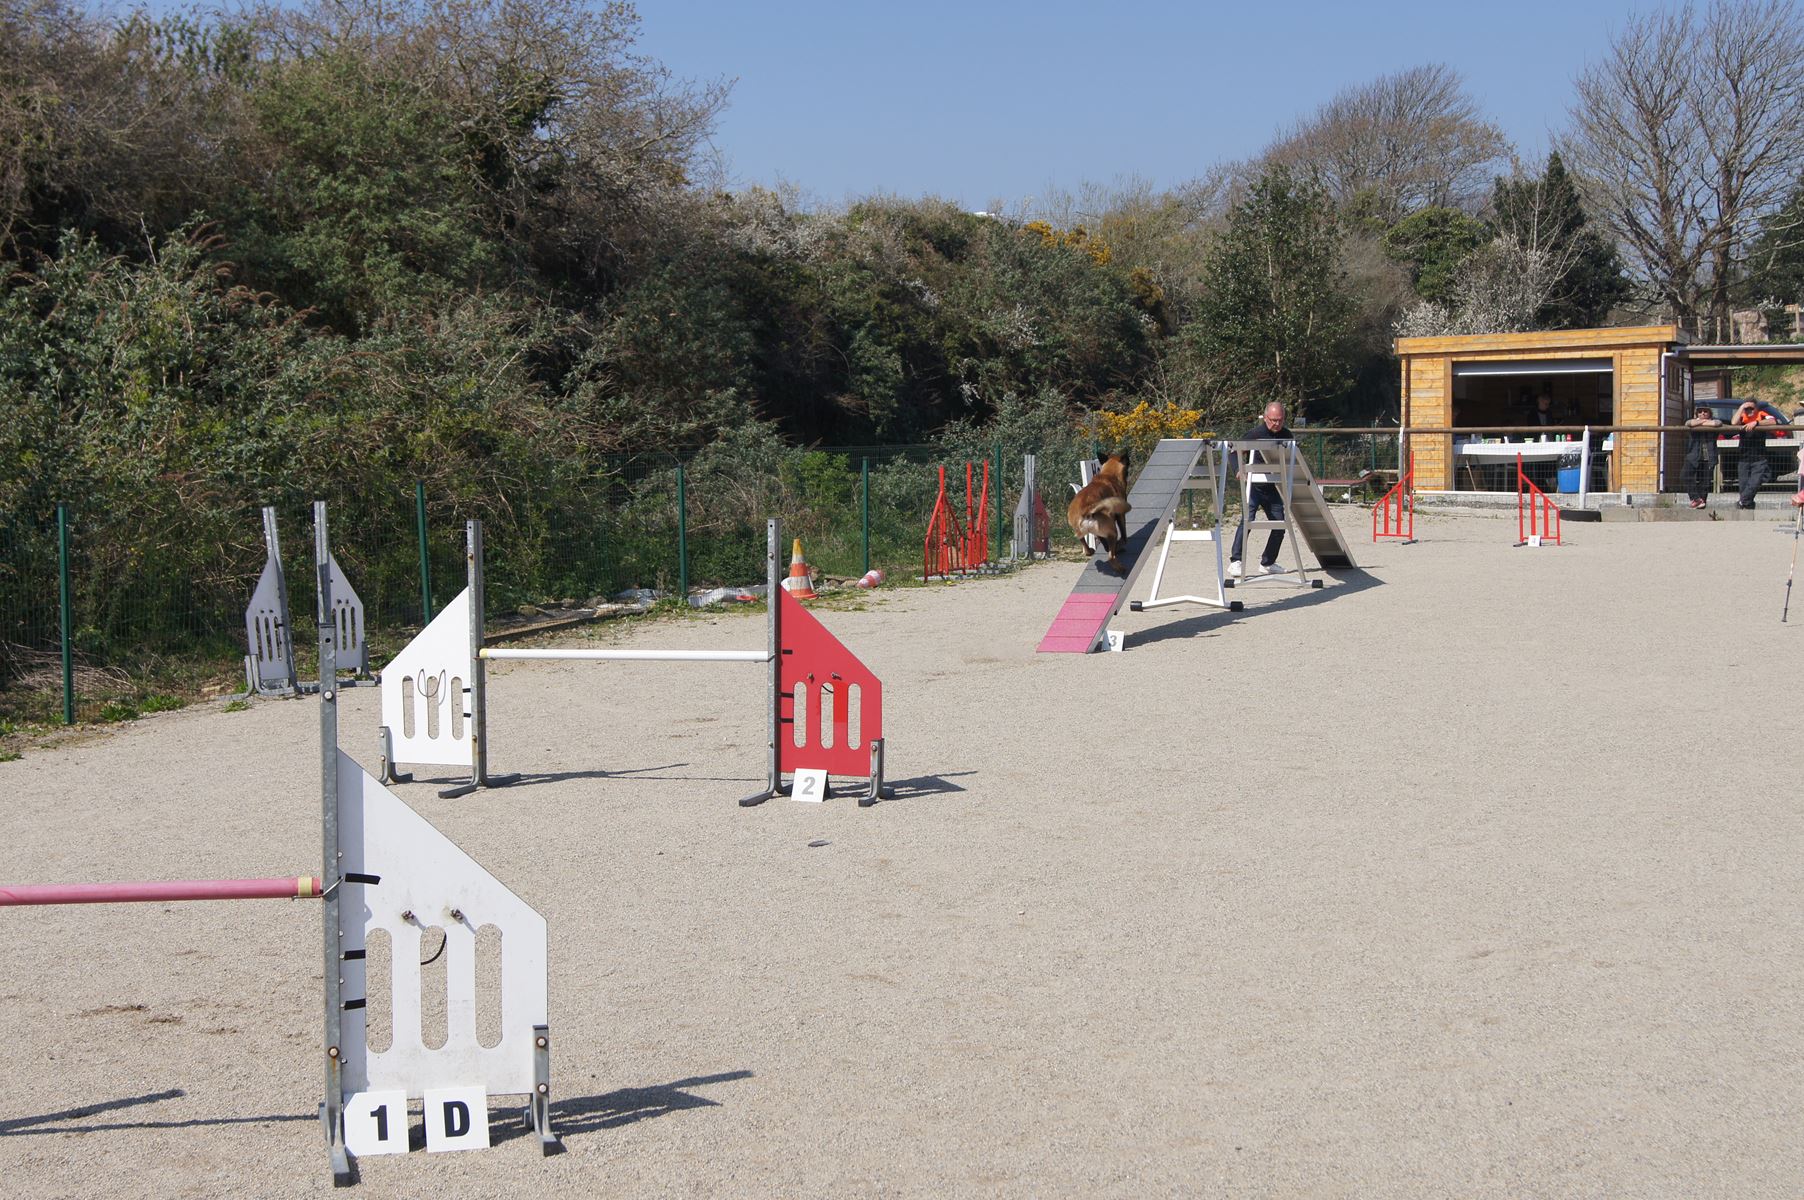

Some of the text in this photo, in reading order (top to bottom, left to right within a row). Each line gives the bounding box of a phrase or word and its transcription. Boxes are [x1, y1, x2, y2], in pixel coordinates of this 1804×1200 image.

[1110, 635, 1117, 647] 3
[801, 776, 816, 795] 2
[370, 1104, 388, 1141] 1
[443, 1101, 471, 1138] D
